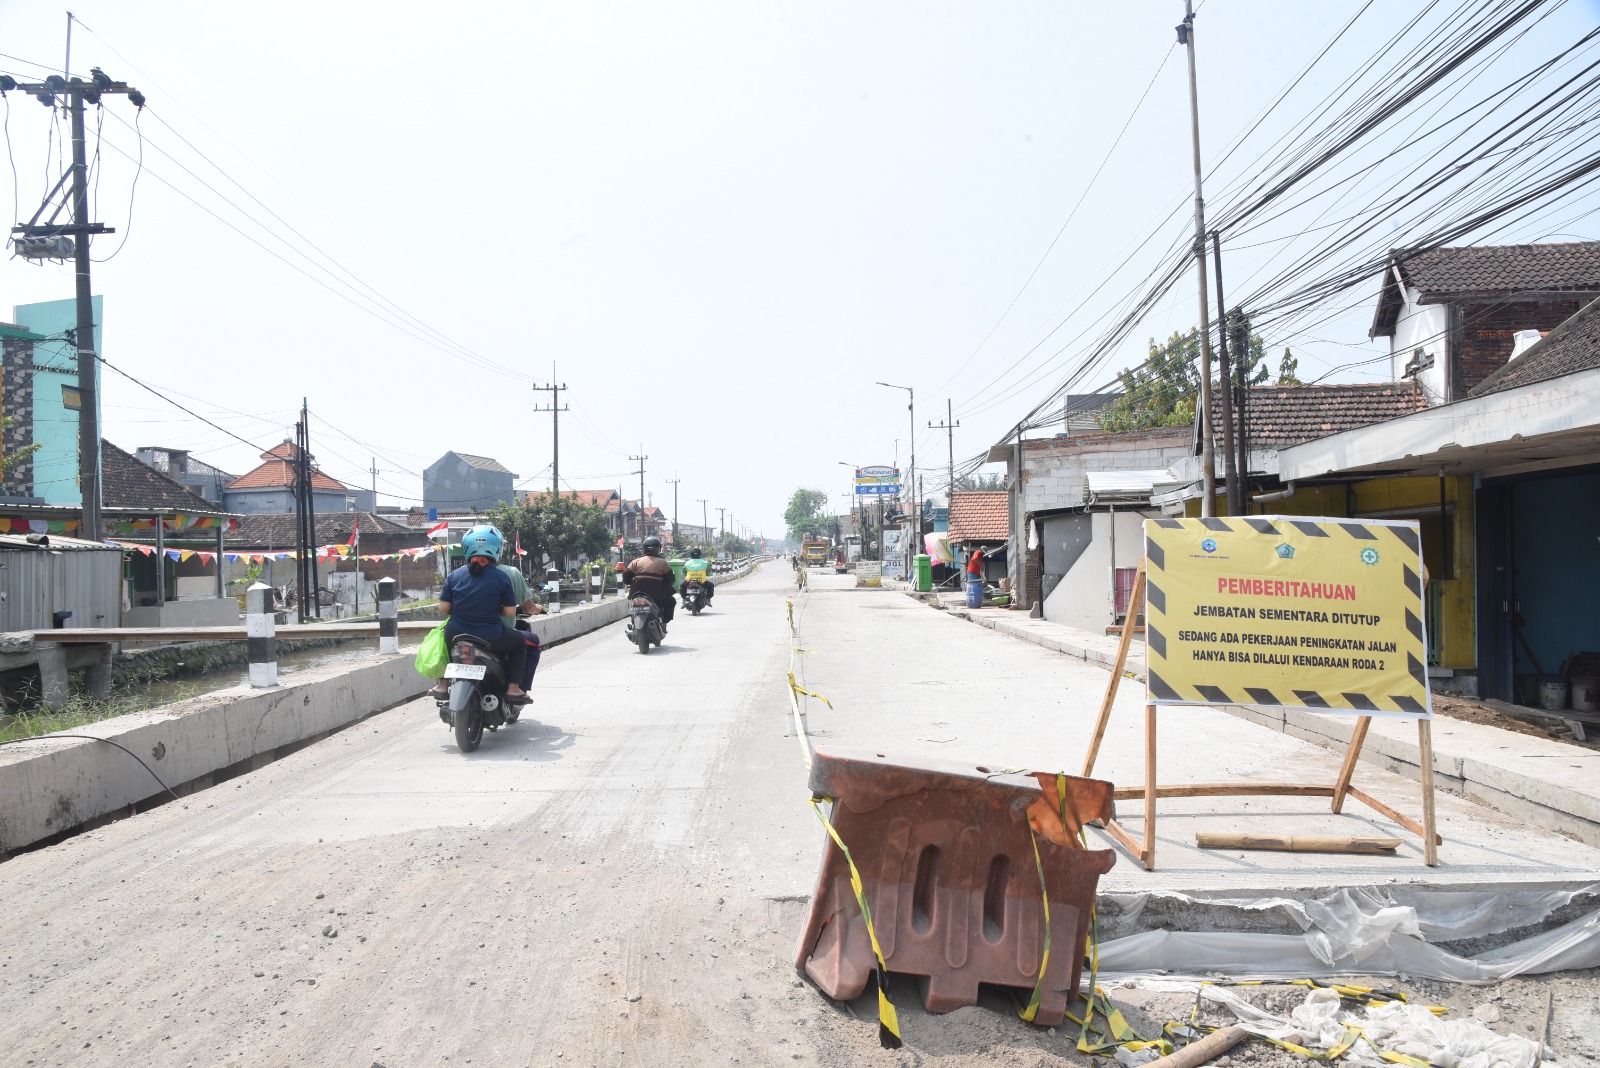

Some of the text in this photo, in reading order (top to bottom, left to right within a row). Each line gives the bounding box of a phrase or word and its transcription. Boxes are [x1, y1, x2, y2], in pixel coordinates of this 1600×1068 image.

[1217, 577, 1356, 601] PEMBERITAHUAN
[1193, 605, 1381, 626] JEMBATAN SEMENTARA DITUTUP
[1178, 630, 1397, 653] SEDANG ADA PEKERJAAN PENINGKATAN JALAN
[1193, 649, 1385, 671] HANYA BISA DILALUI KENDARAAN RODA 2
